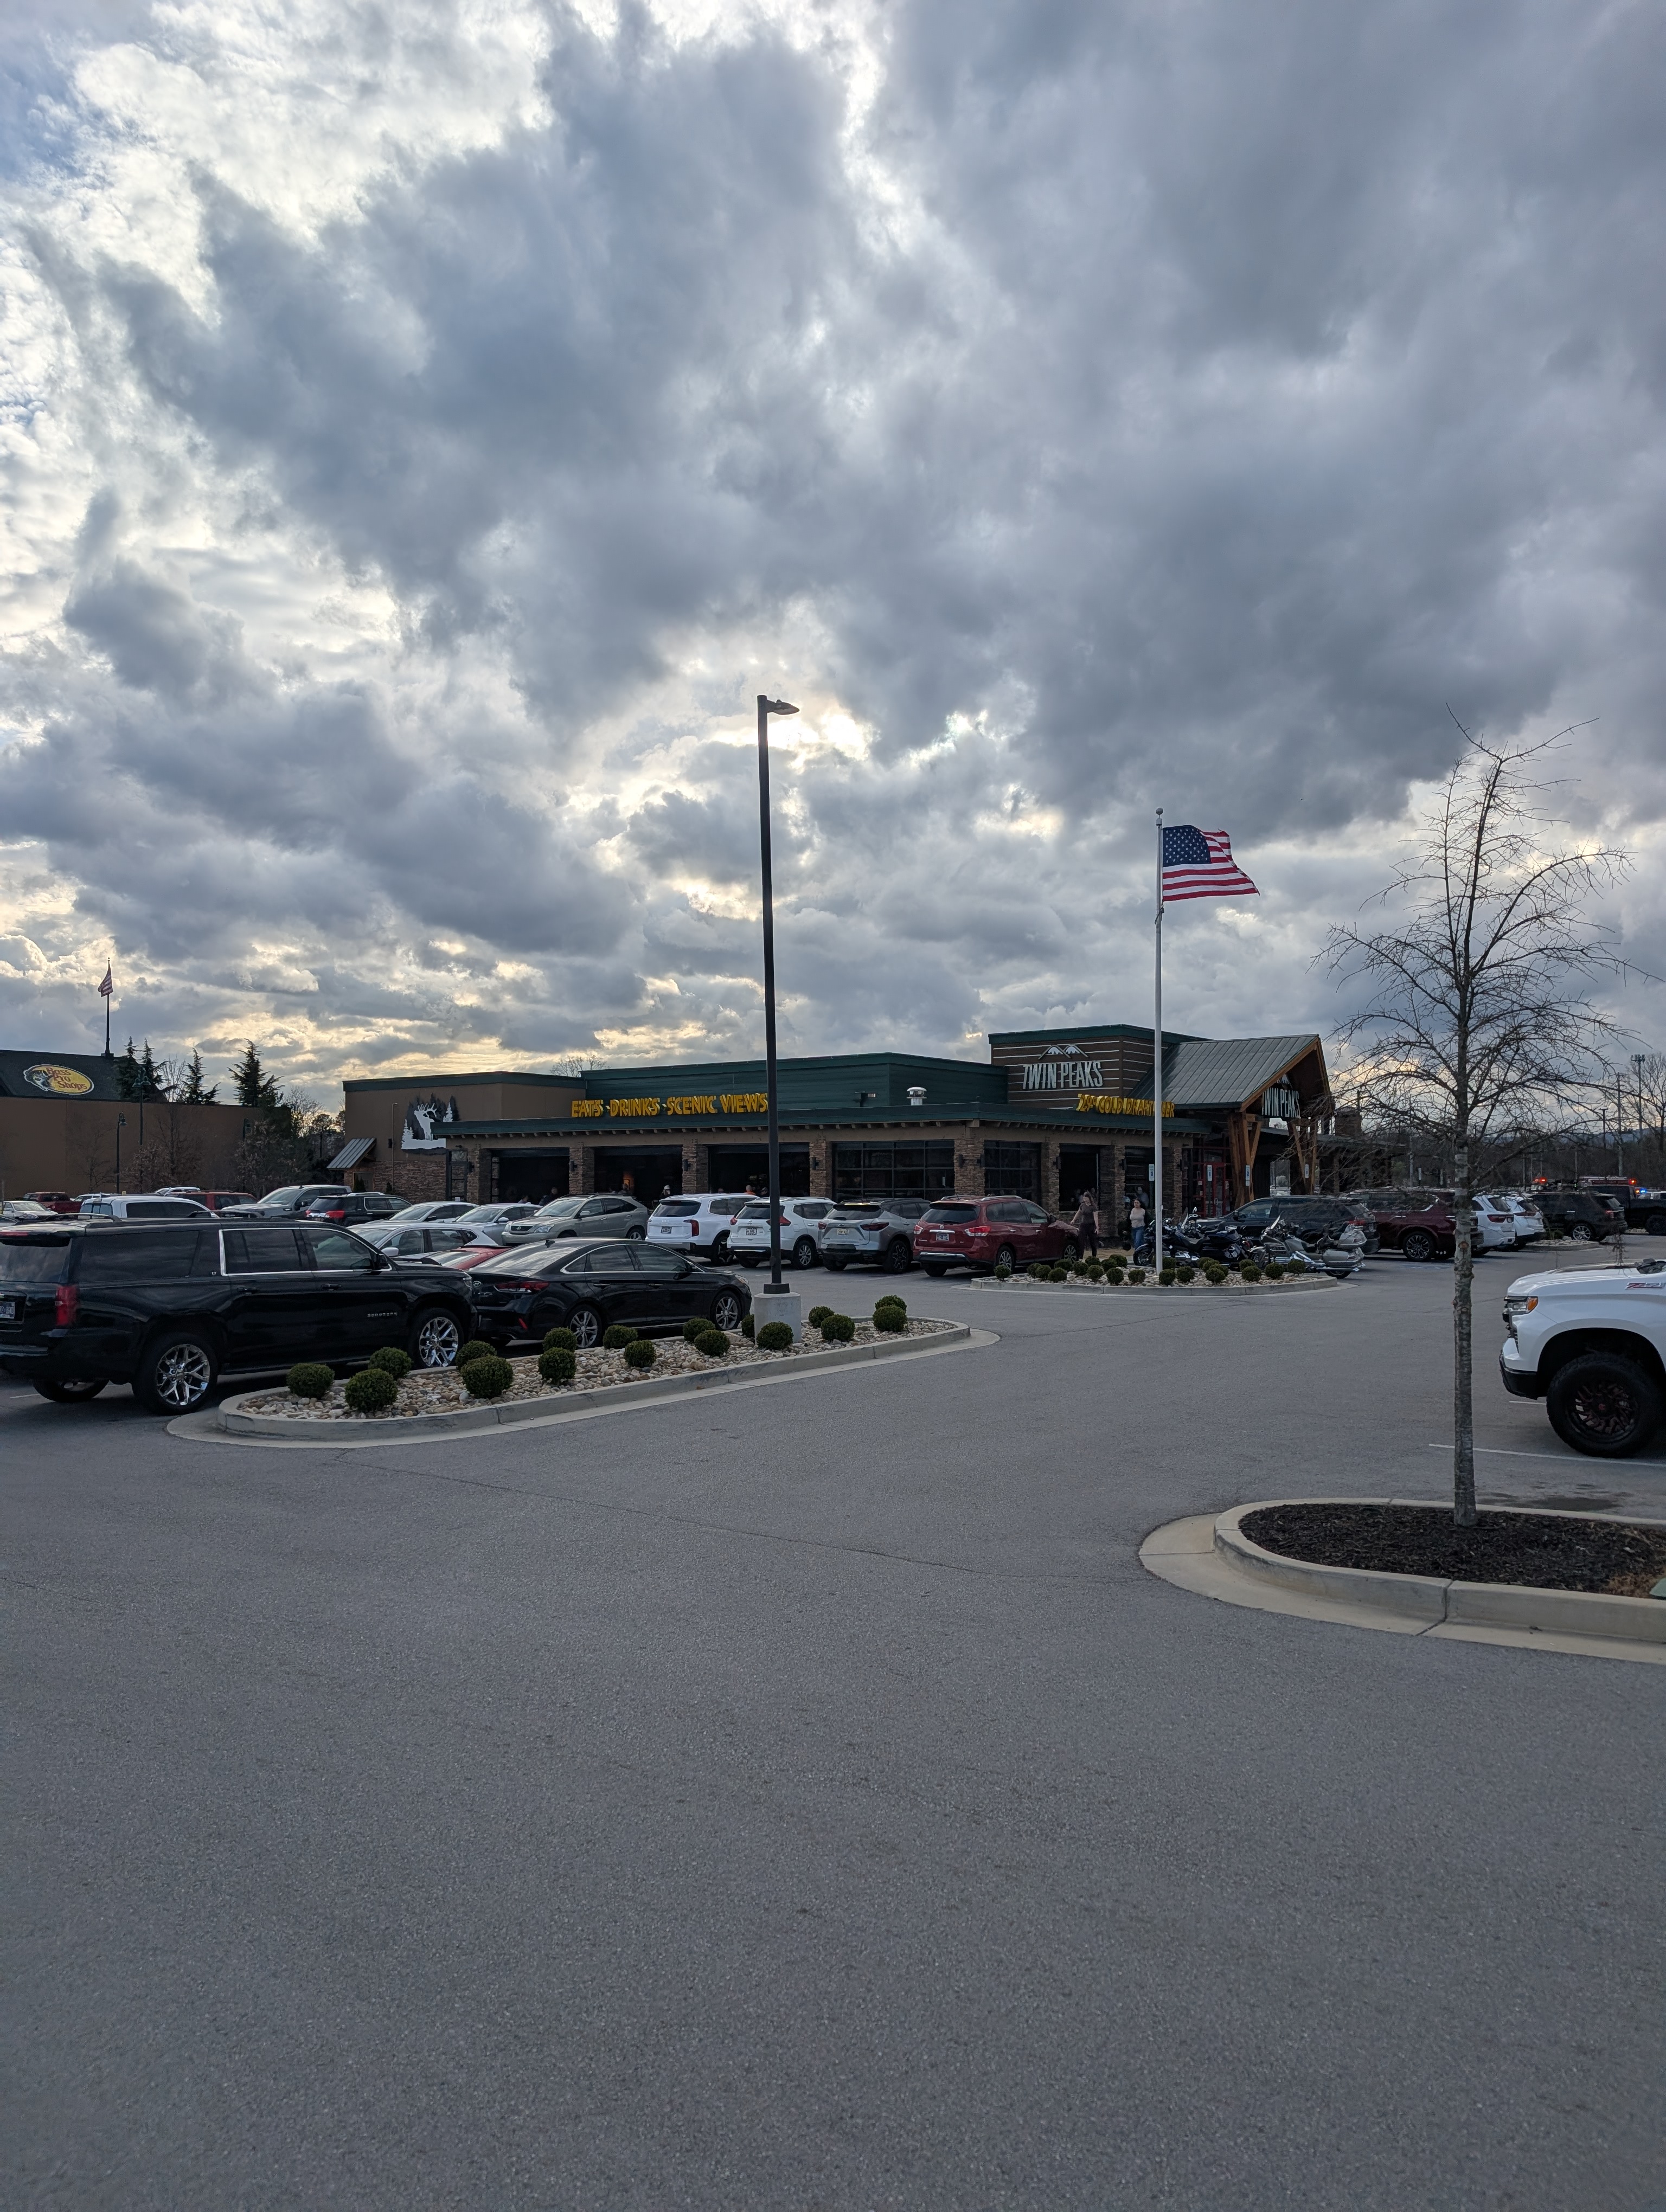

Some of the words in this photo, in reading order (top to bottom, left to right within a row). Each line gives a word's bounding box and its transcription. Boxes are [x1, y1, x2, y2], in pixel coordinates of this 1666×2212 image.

[46, 1067, 71, 1076] Bass
[53, 1073, 71, 1082] Pro
[1023, 1063, 1057, 1089] TWIN
[1060, 1060, 1103, 1088] PEAKS
[57, 1081, 87, 1091] Shops
[572, 1099, 604, 1117] EATS
[610, 1097, 661, 1117] DRINKS
[667, 1096, 718, 1115] SCENIC
[719, 1093, 768, 1114] VIEWS
[1097, 1096, 1123, 1114] COLD
[1123, 1098, 1154, 1116] DRAFT
[1155, 1101, 1175, 1118] EER
[1280, 1089, 1300, 1118] PEAKS
